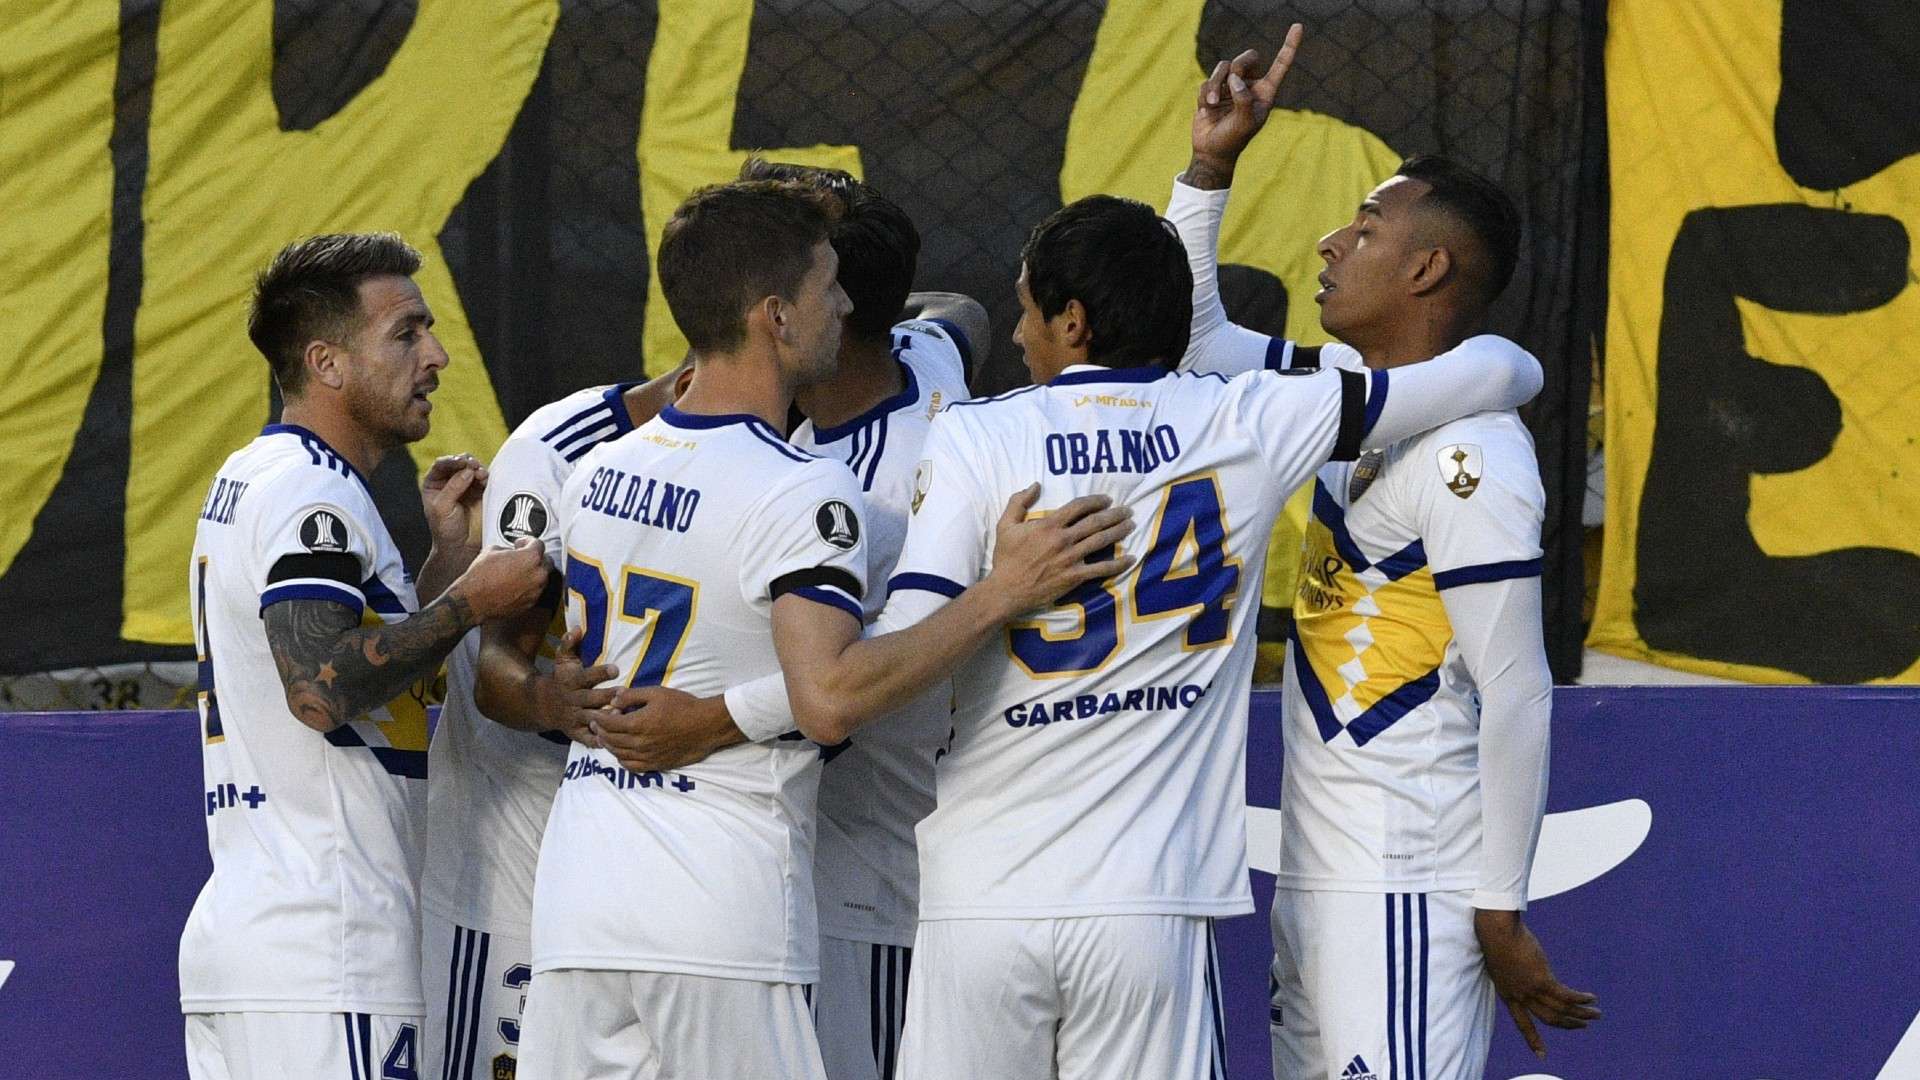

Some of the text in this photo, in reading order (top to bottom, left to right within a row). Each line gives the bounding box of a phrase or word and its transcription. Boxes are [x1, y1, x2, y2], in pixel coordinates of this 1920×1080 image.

[1045, 423, 1181, 476] OBANDO
[1458, 473, 1468, 486] 6
[581, 466, 701, 533] SOLDANO
[1005, 470, 1244, 681] 34
